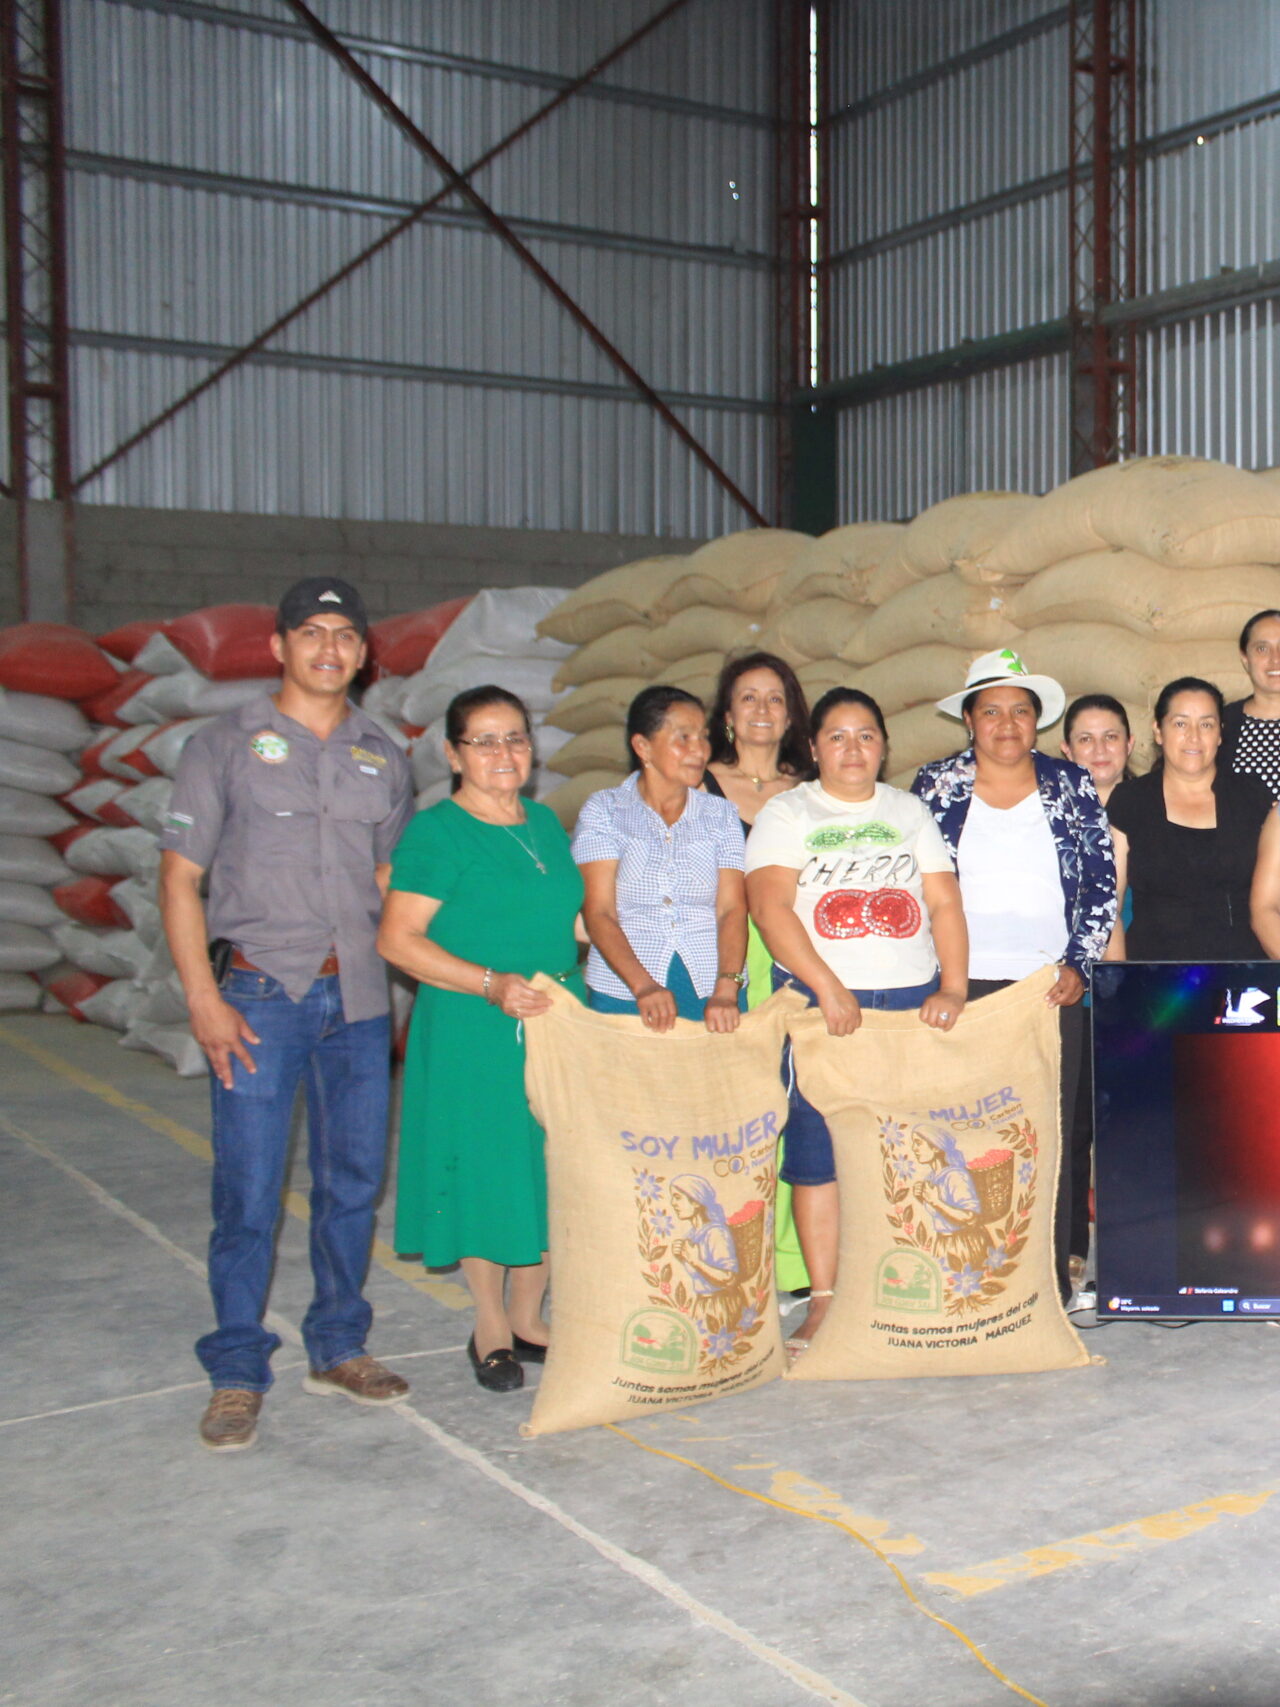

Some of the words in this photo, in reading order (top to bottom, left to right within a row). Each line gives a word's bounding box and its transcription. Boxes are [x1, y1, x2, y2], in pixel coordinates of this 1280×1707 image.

[928, 1085, 1022, 1122] MUJER
[619, 1130, 680, 1160] SOY
[692, 1110, 779, 1161] MUJER
[870, 1319, 909, 1335] Juntas
[912, 1325, 953, 1336] somos
[955, 1312, 1004, 1333] mujeres
[1005, 1302, 1021, 1317] del
[888, 1336, 923, 1348] JUANA
[925, 1335, 978, 1349] VICTORIA
[611, 1376, 656, 1393] Juntas
[657, 1383, 698, 1394] somos
[628, 1394, 663, 1405] JUANA
